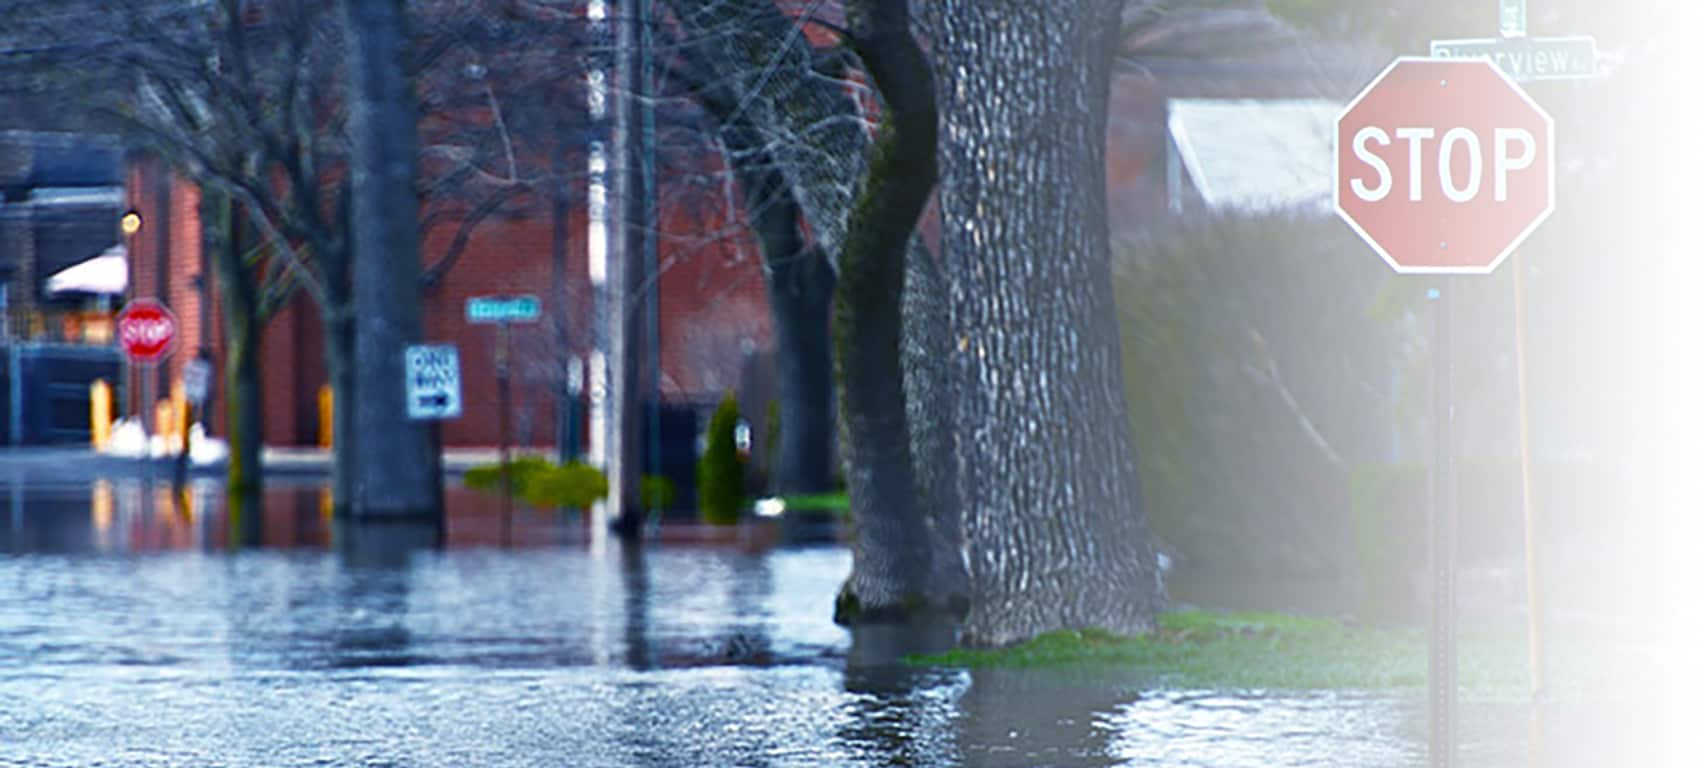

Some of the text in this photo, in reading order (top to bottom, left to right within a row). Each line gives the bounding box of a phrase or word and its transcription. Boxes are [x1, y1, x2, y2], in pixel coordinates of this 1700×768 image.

[1438, 47, 1568, 74] rview
[1350, 126, 1537, 203] STOP
[121, 317, 171, 344] STOP
